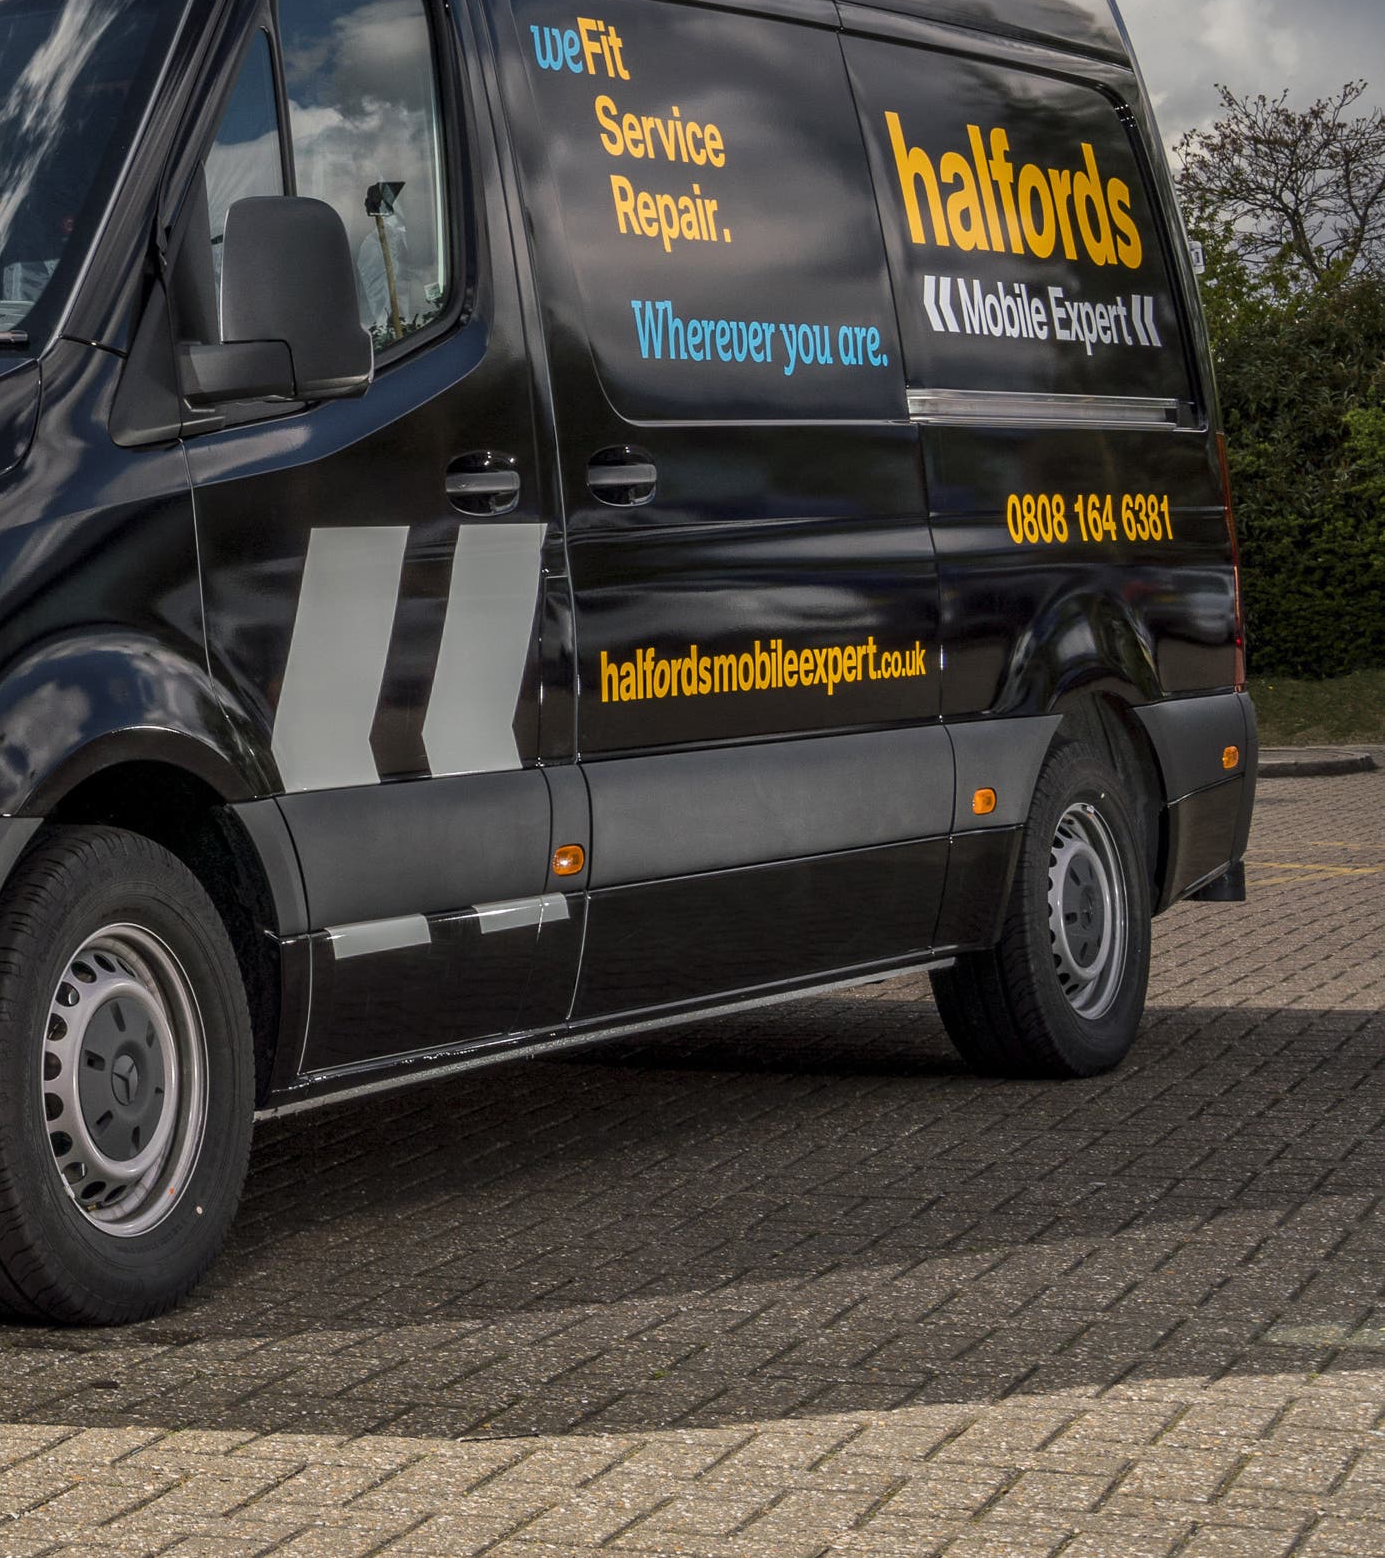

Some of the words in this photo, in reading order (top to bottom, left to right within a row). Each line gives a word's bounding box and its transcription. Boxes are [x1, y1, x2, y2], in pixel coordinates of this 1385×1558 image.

[529, 17, 631, 80] weFit
[595, 95, 726, 168] Service
[610, 174, 732, 253] Repair.
[884, 111, 1142, 269] halfords
[631, 300, 775, 362] Wherever
[779, 323, 833, 376] you
[838, 325, 888, 367] are.
[957, 278, 1048, 340] Mobile
[1048, 286, 1133, 356] Expert
[1006, 493, 1070, 544] 0808
[1073, 493, 1117, 542] 164
[1120, 493, 1174, 541] 6381
[600, 636, 927, 703] halfordsmobileexpert.co.uk
